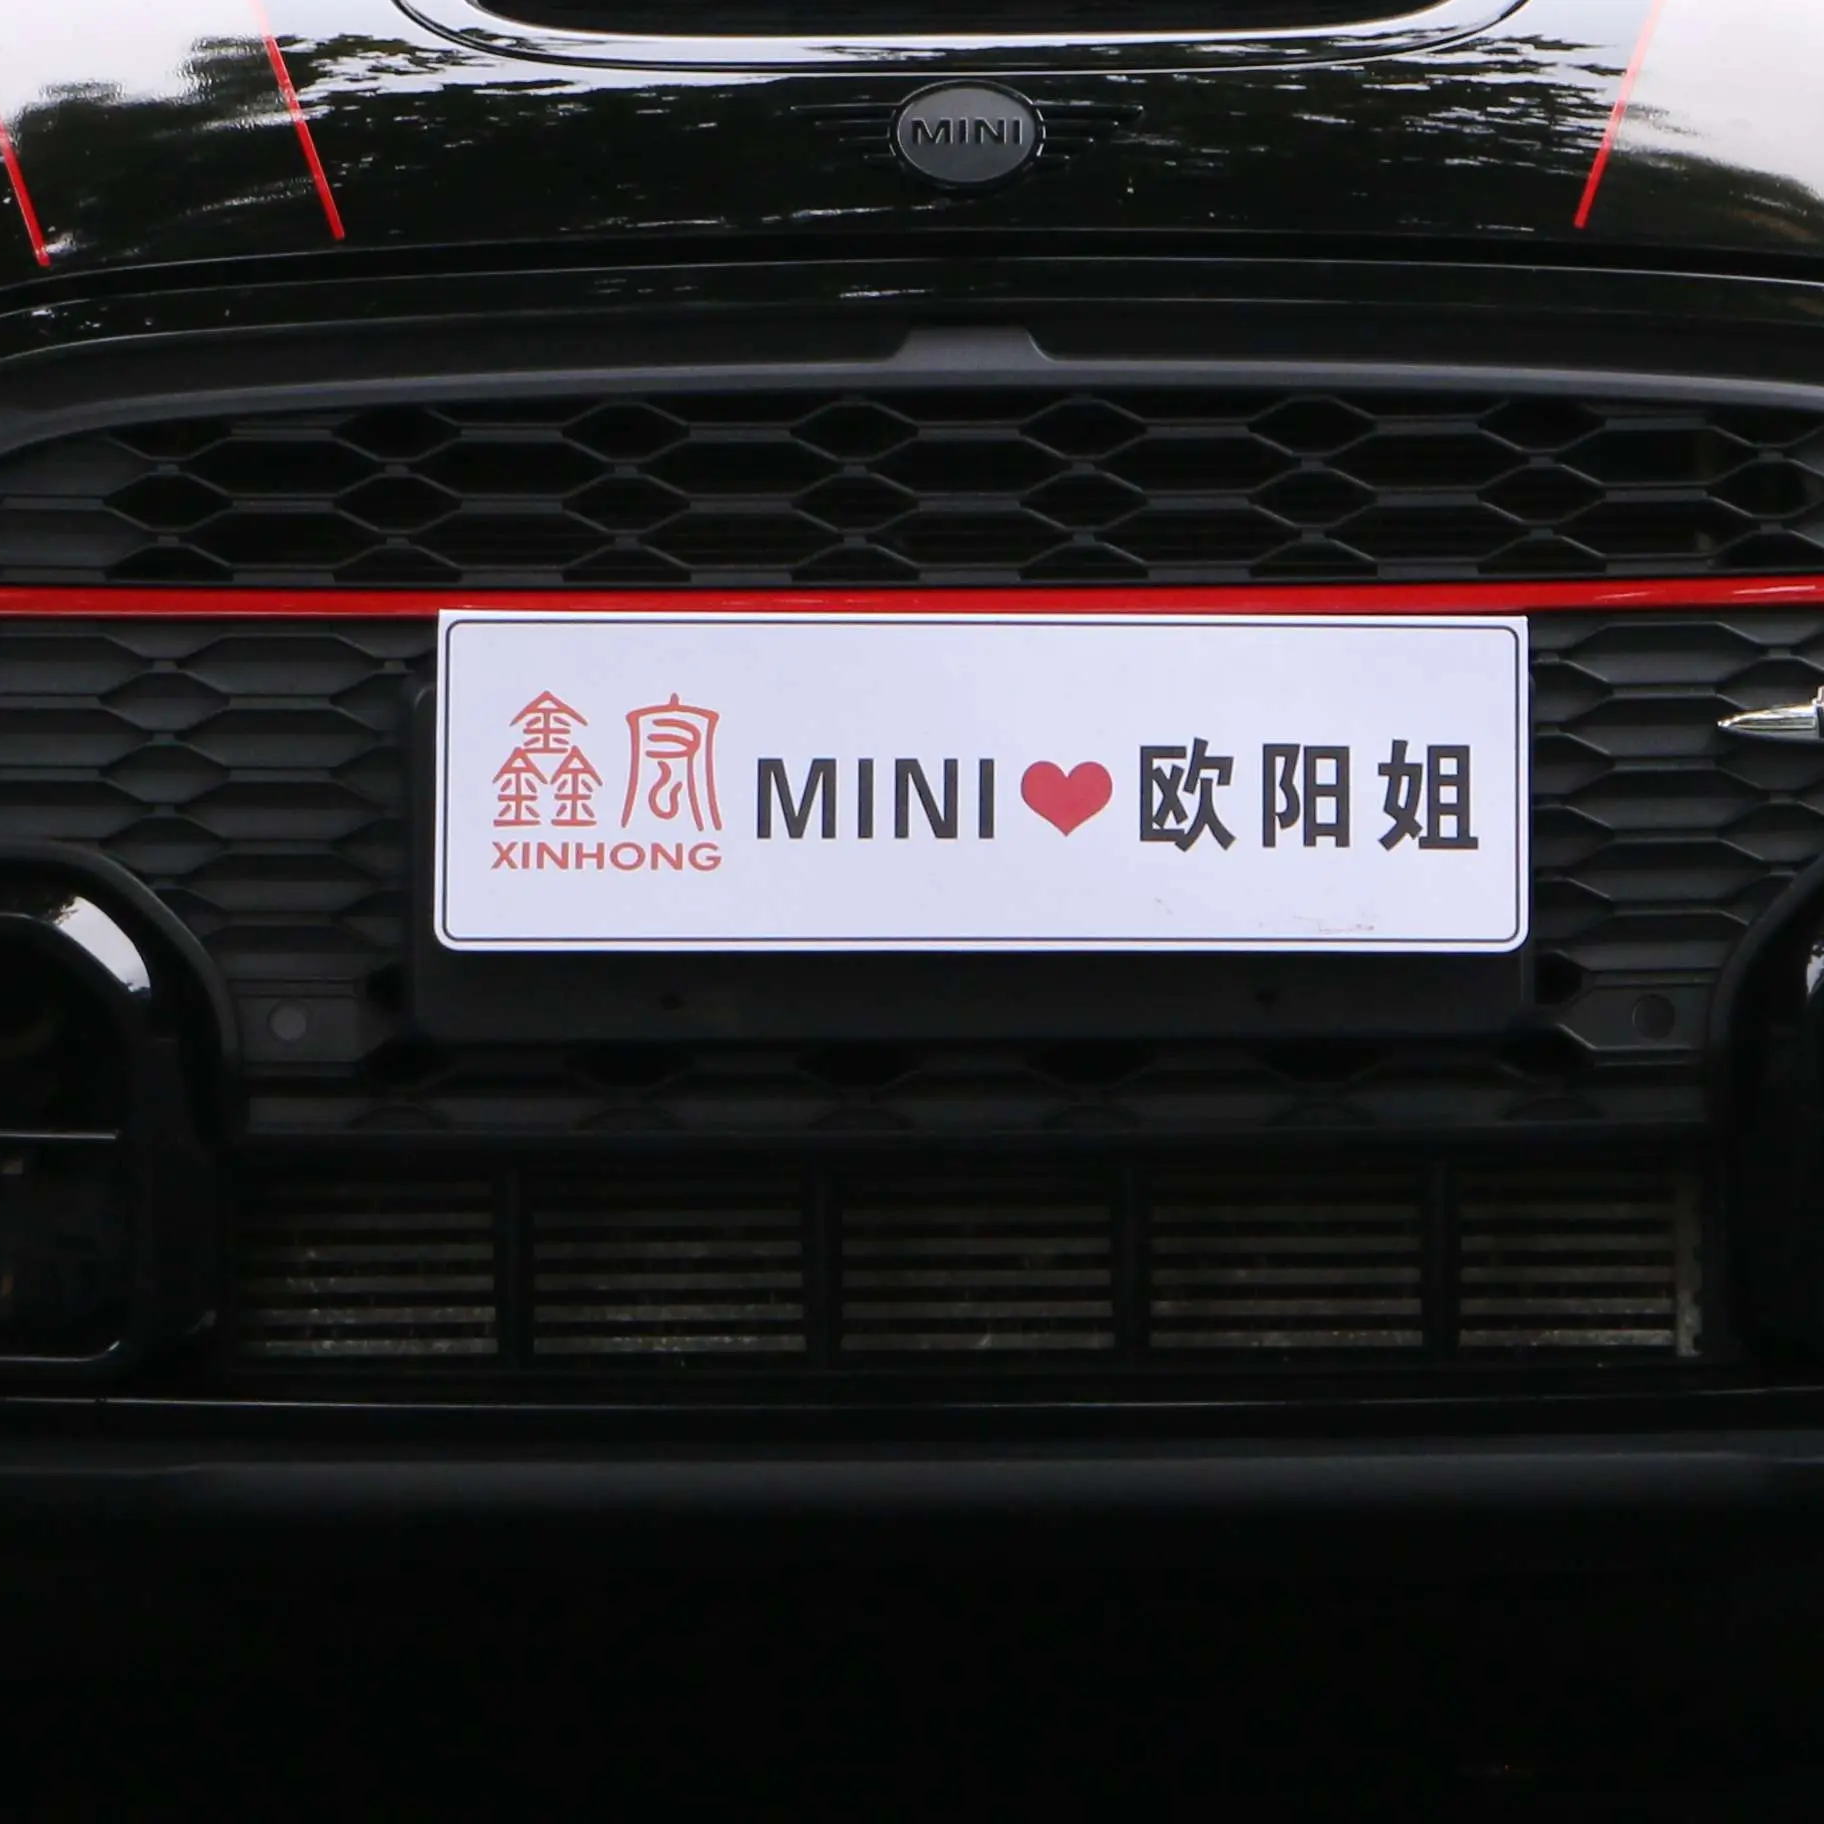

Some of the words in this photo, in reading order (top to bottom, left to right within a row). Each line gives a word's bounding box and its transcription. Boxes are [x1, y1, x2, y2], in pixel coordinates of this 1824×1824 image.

[910, 116, 1024, 145] MINI
[758, 759, 994, 838] MINI
[1140, 739, 1478, 851] 欧阳姐
[491, 841, 722, 872] XINHONG
